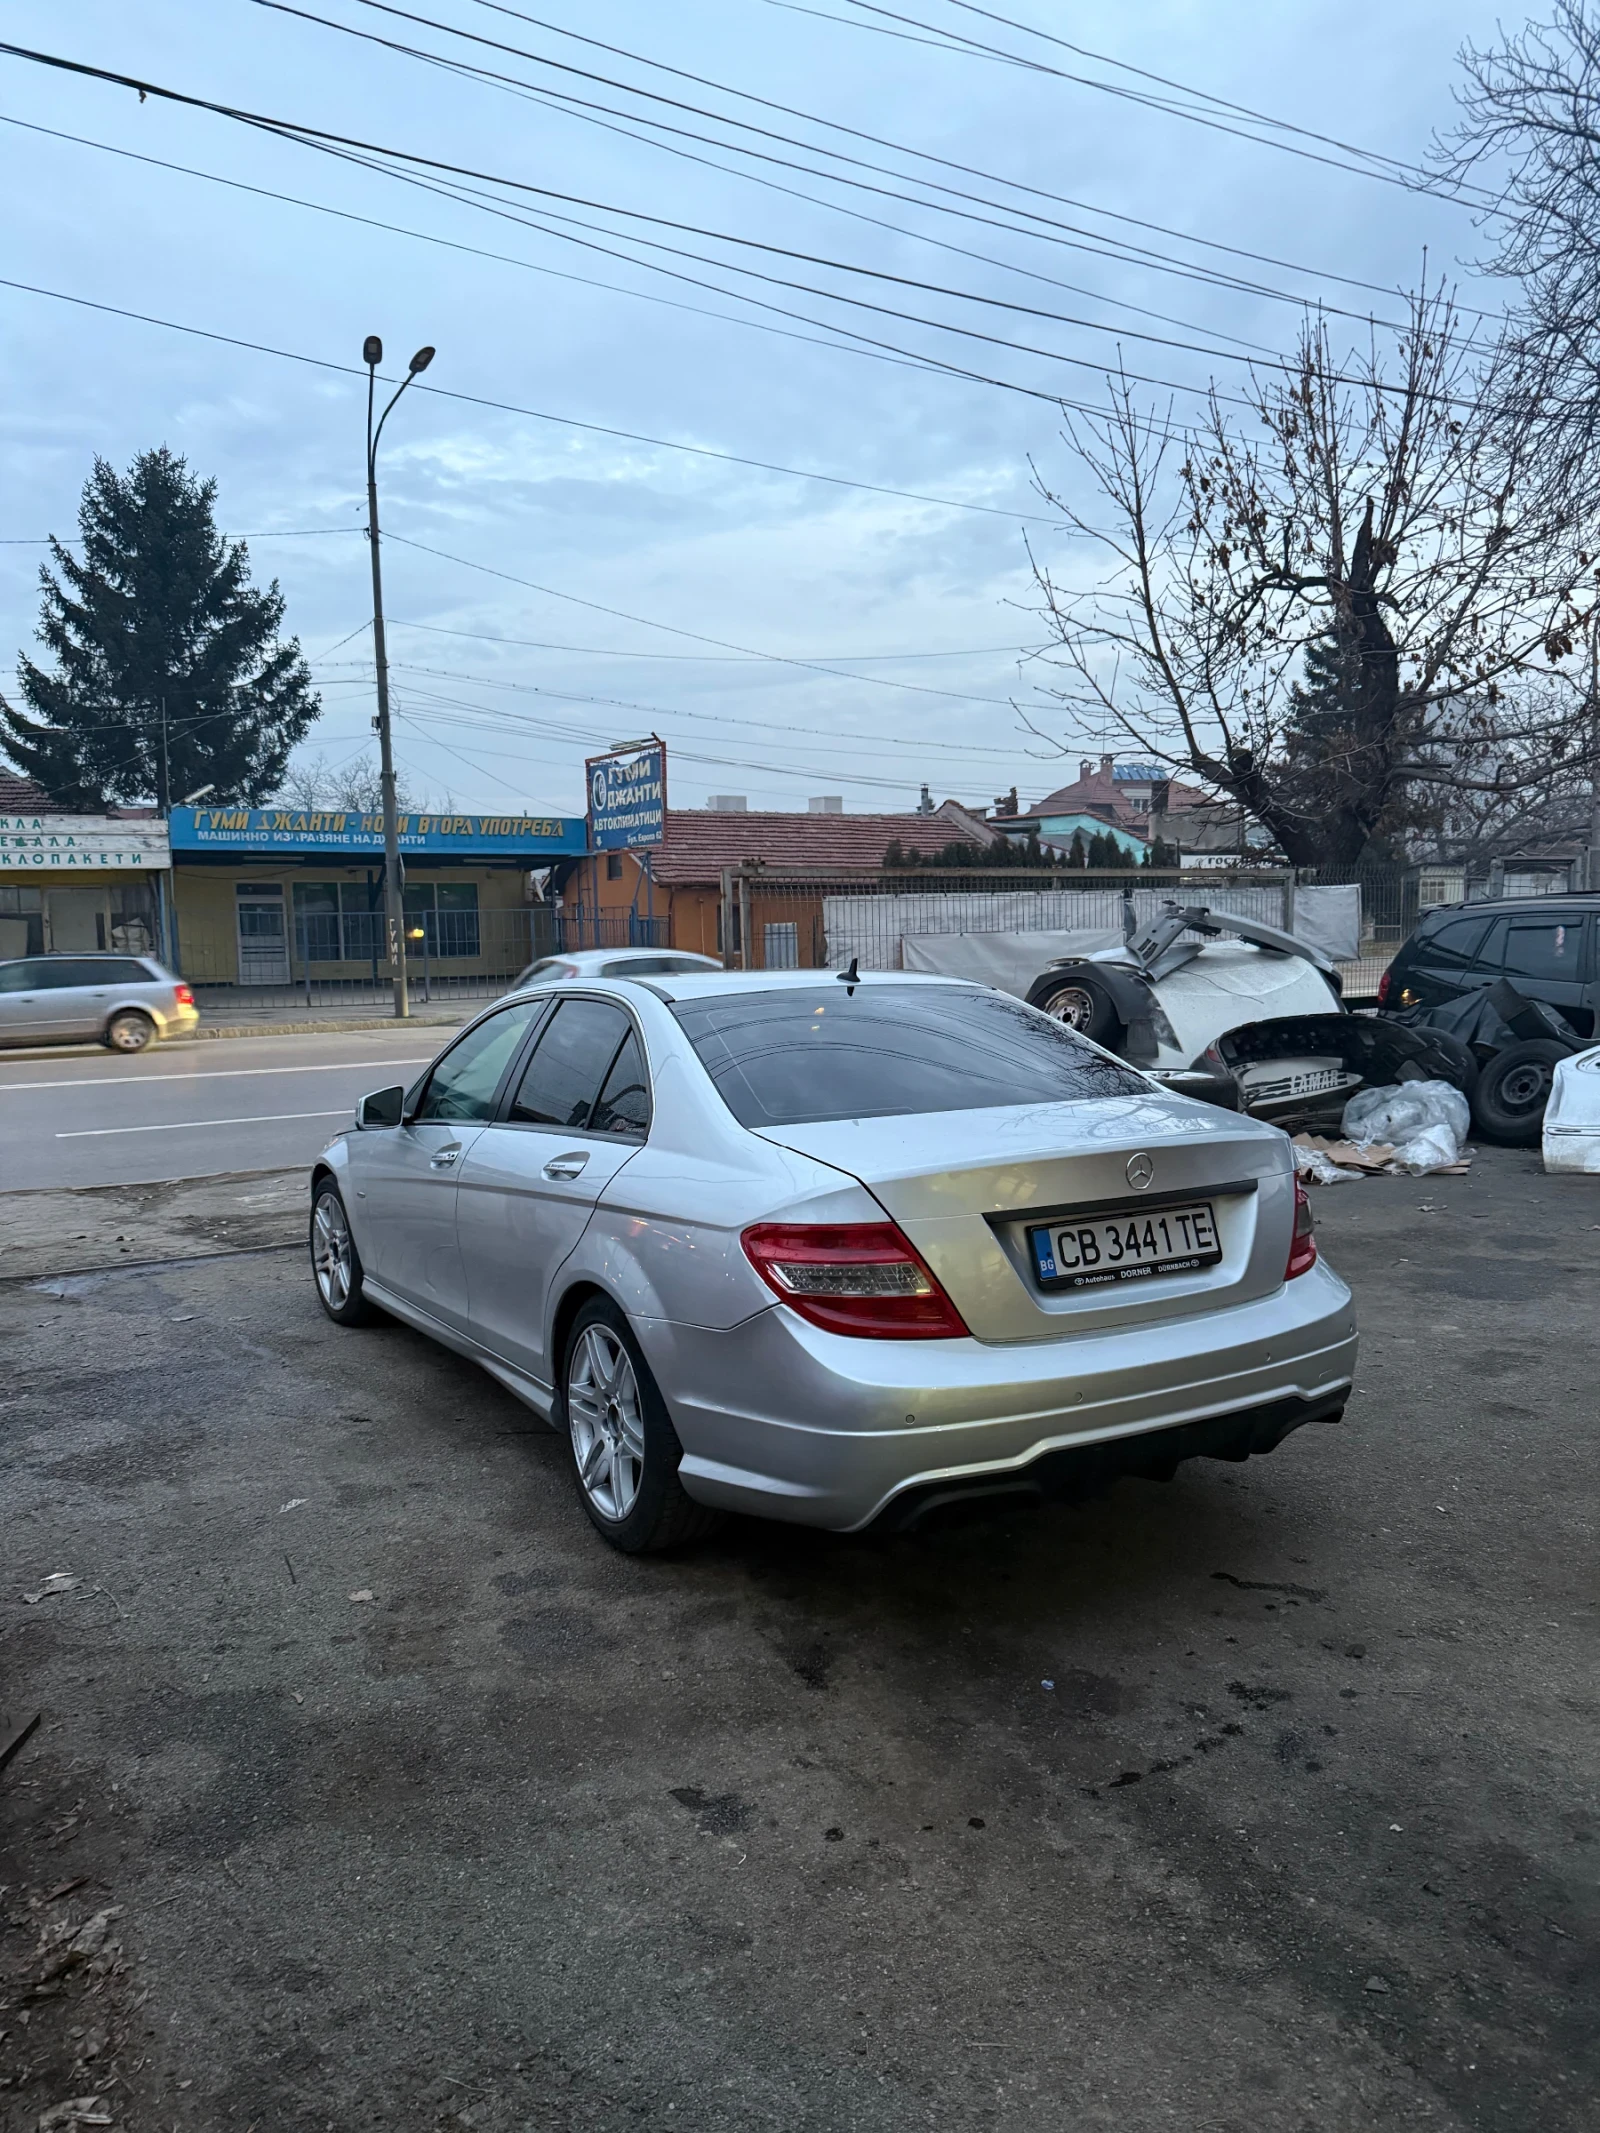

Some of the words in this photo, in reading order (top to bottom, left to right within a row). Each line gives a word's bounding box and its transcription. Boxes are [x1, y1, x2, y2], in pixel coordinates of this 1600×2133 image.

[608, 759, 651, 785] ГУМИ
[607, 781, 661, 811] ДЖАНТИ
[194, 810, 250, 830] ГУМИ
[255, 812, 346, 832] ДЖАНТИ
[360, 814, 410, 834] НОИ
[418, 815, 474, 836] ВТОРА
[479, 817, 565, 838] УПОТРЕБА
[593, 809, 662, 832] АВТОКЛИМАТИЦИ
[197, 830, 269, 842] МАШИННО
[353, 834, 371, 844] НА
[389, 918, 399, 966] ГУМИ
[1057, 1228, 1101, 1268] CB
[1105, 1217, 1172, 1261] 3441
[1175, 1212, 1212, 1249] TE
[1039, 1258, 1055, 1273] BG
[1084, 1273, 1116, 1286] Autohaus
[1120, 1266, 1152, 1280] DORNER
